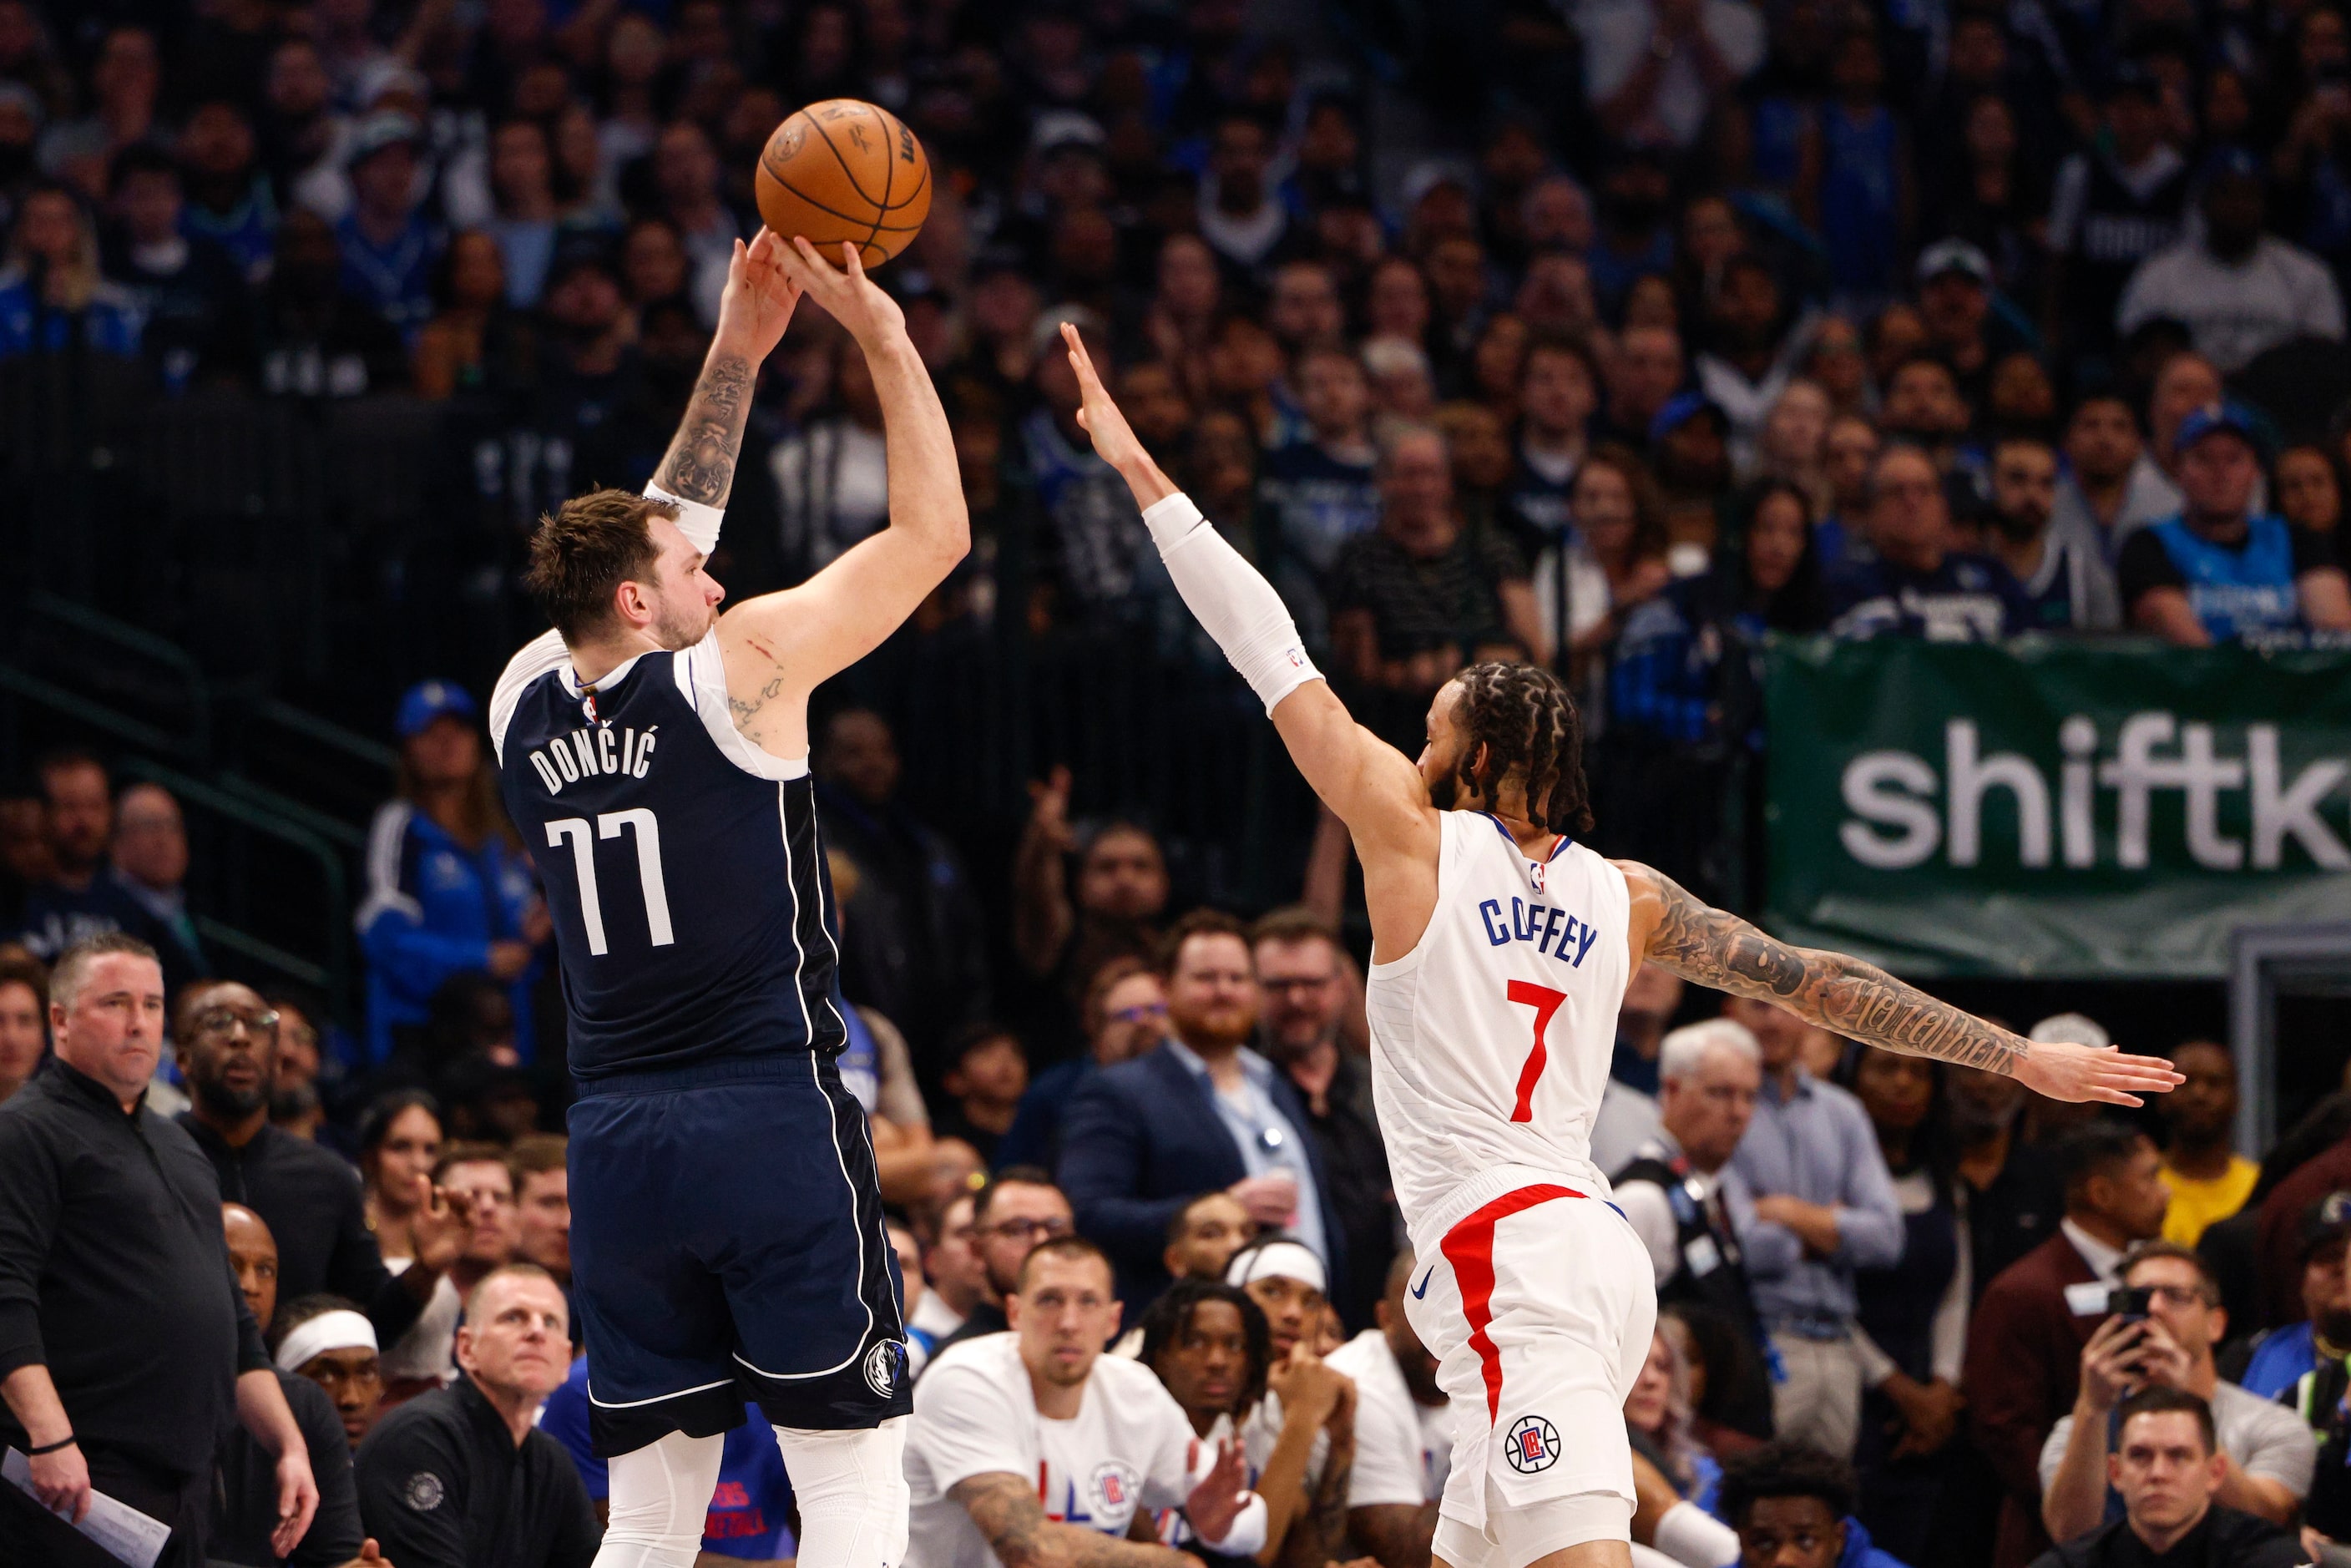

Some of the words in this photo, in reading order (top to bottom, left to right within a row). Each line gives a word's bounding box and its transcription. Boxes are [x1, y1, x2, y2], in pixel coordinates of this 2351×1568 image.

[528, 719, 659, 797] DONČIĆ
[544, 807, 675, 956] 77
[1479, 896, 1597, 969] COFFEY
[1507, 979, 1568, 1123] 7
